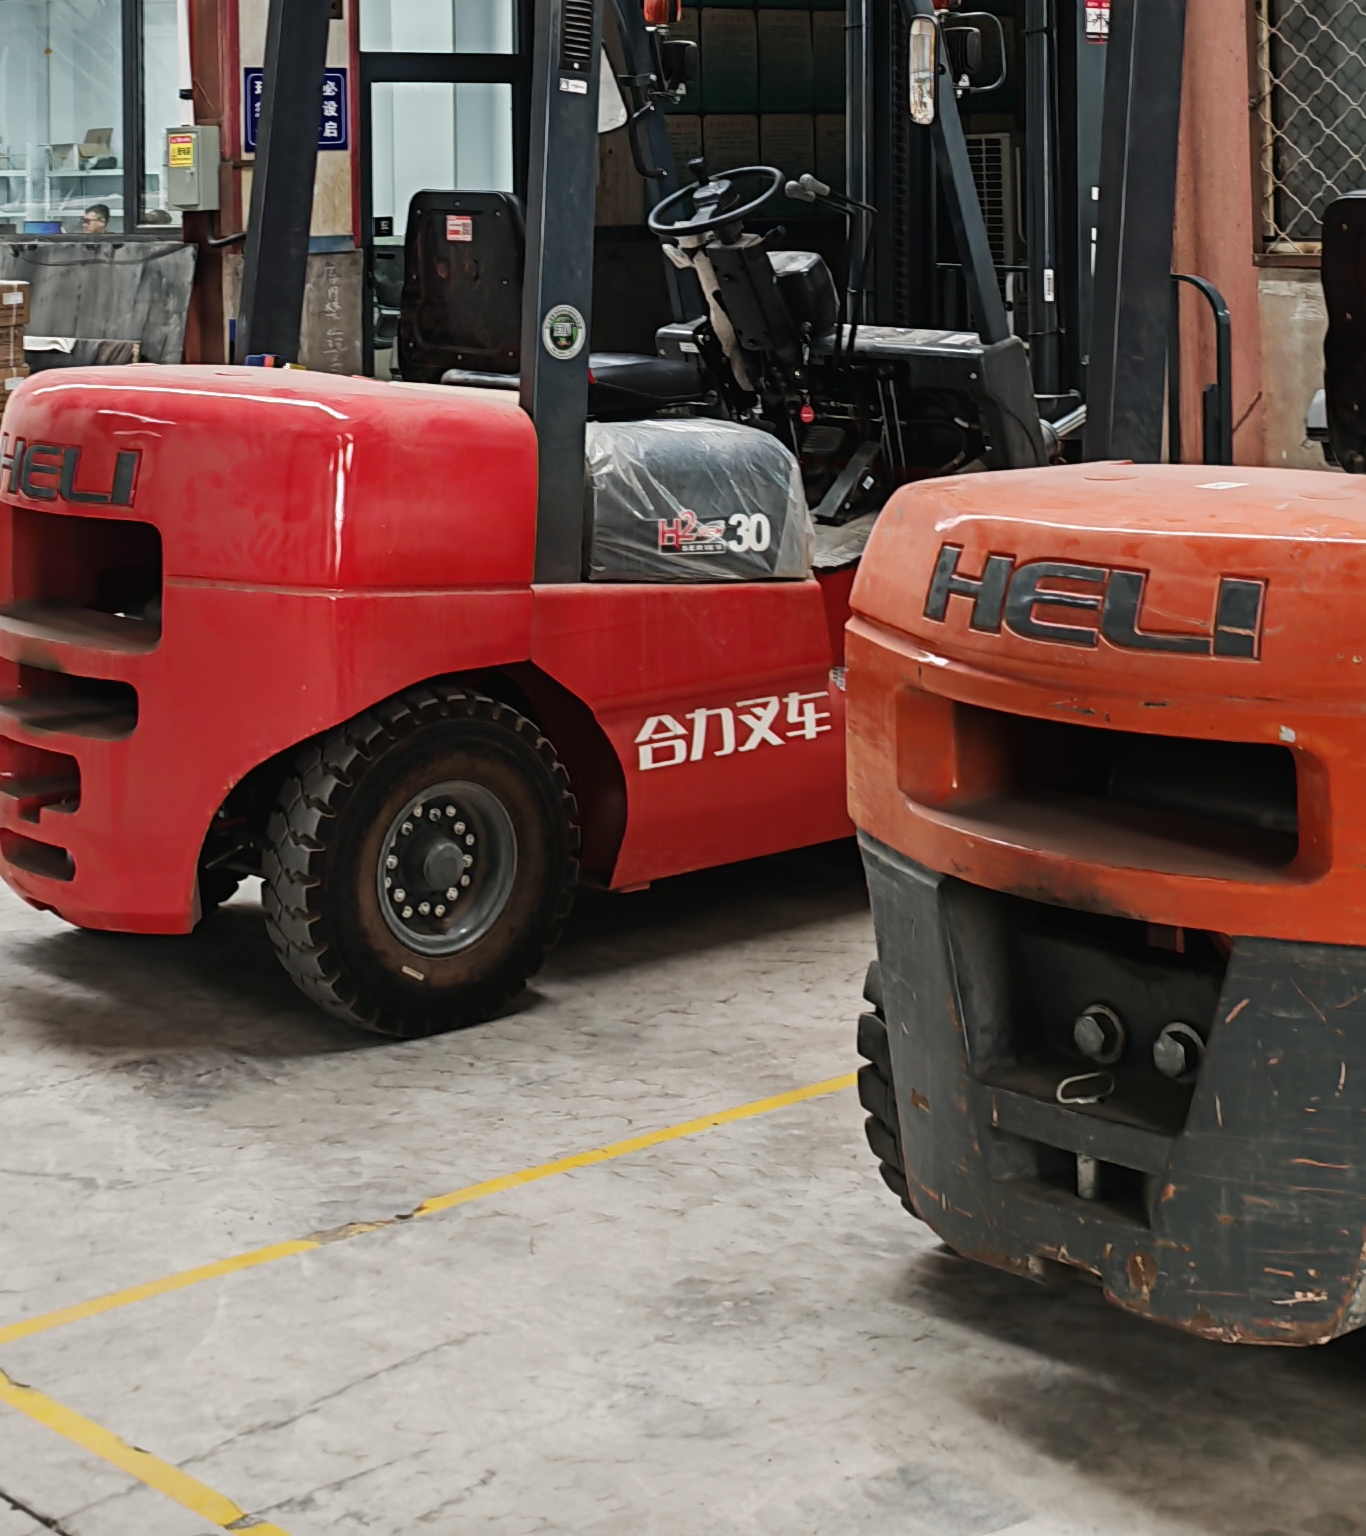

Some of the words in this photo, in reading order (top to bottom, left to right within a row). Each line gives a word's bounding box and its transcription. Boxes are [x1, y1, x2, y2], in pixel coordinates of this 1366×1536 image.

[728, 512, 771, 553] 30
[922, 542, 1269, 662] HELI
[633, 690, 833, 772] 合力叉车
